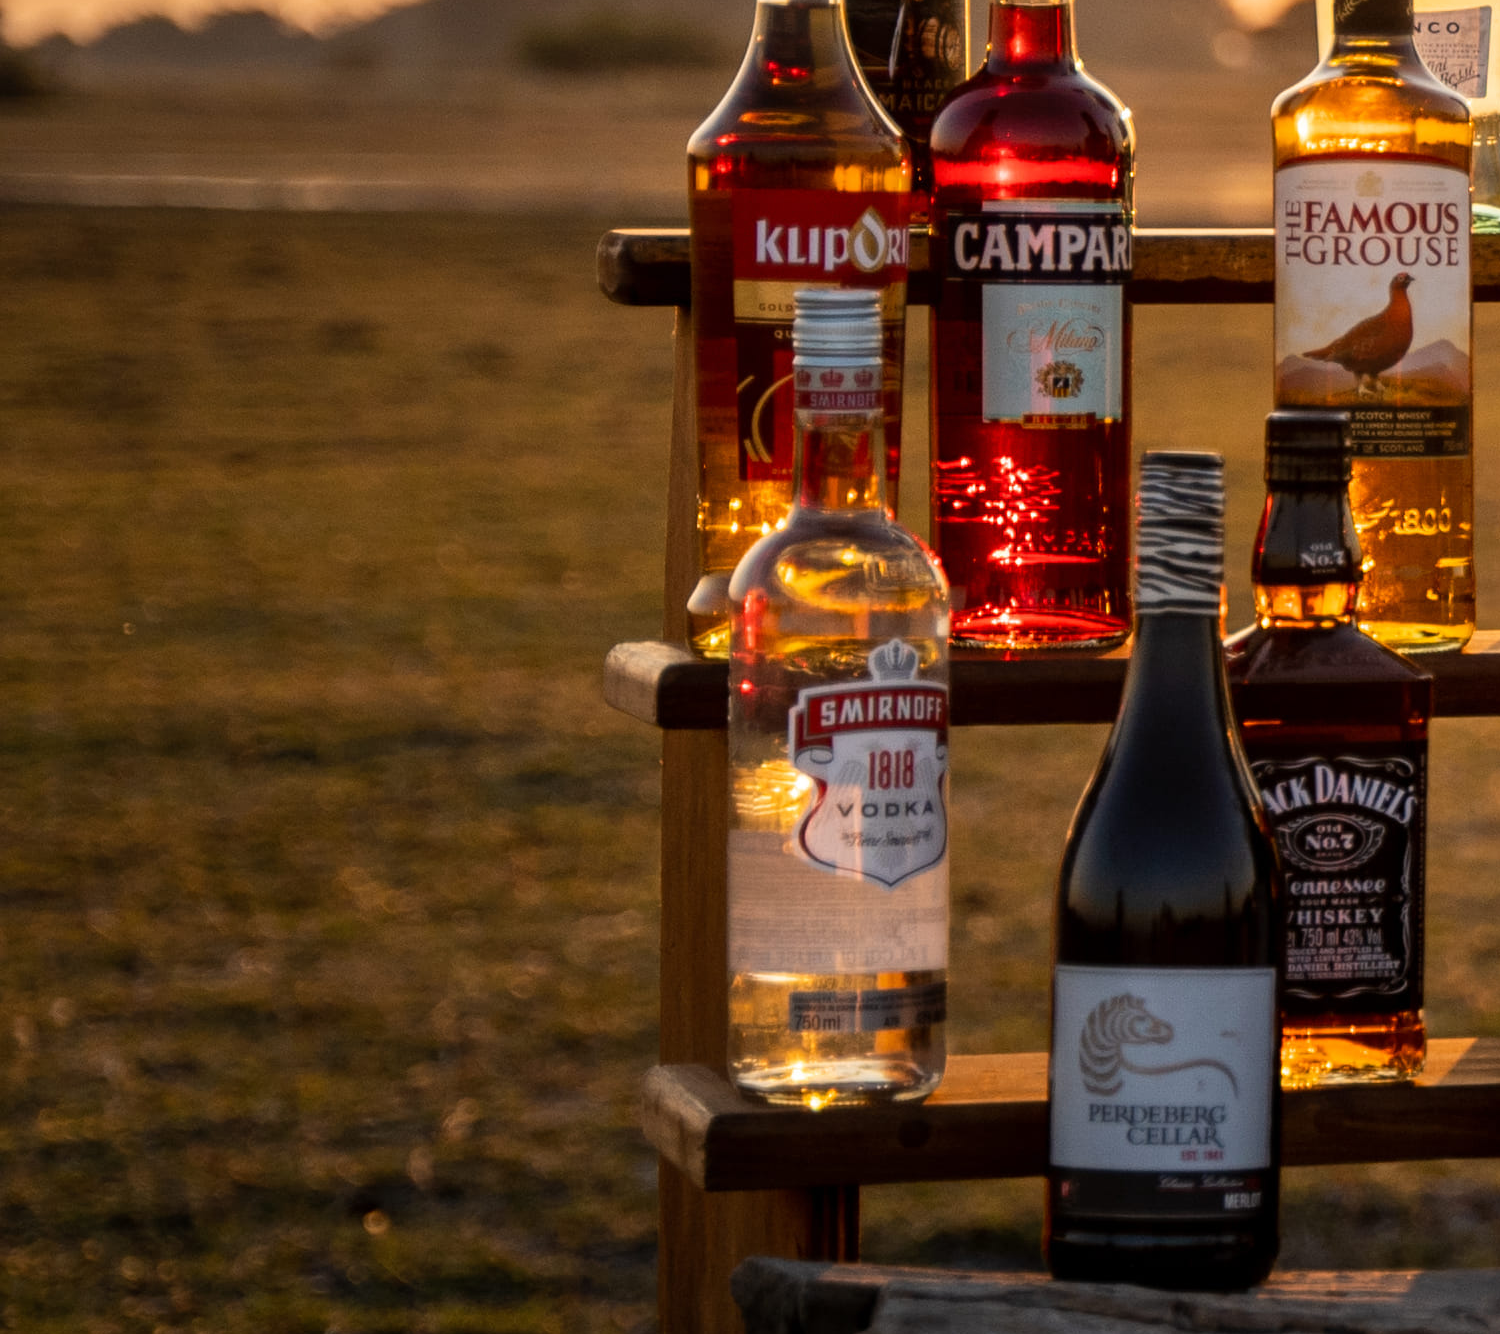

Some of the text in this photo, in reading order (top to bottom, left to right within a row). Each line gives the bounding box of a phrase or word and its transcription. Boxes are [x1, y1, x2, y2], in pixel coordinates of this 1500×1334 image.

[1413, 22, 1460, 34] NCO
[878, 92, 945, 113] MAIC
[1304, 201, 1459, 234] FAMOUS
[756, 214, 909, 271] KLIPDRI
[1285, 200, 1300, 264] THE
[1303, 235, 1459, 266] GROUSE
[809, 392, 877, 407] SMIRNOFF
[1355, 411, 1432, 420] SCOTCH WHISKY
[820, 695, 943, 727] SMIRNOFF
[868, 749, 914, 790] 1818
[1261, 776, 1312, 815] ACK
[837, 800, 934, 817] VODKA
[1286, 874, 1386, 896] ennessee
[1287, 909, 1384, 925] HISKEY
[795, 1015, 820, 1030] 750
[1088, 1104, 1226, 1126] PERDEBERG
[1126, 1127, 1225, 1148] CELLAR
